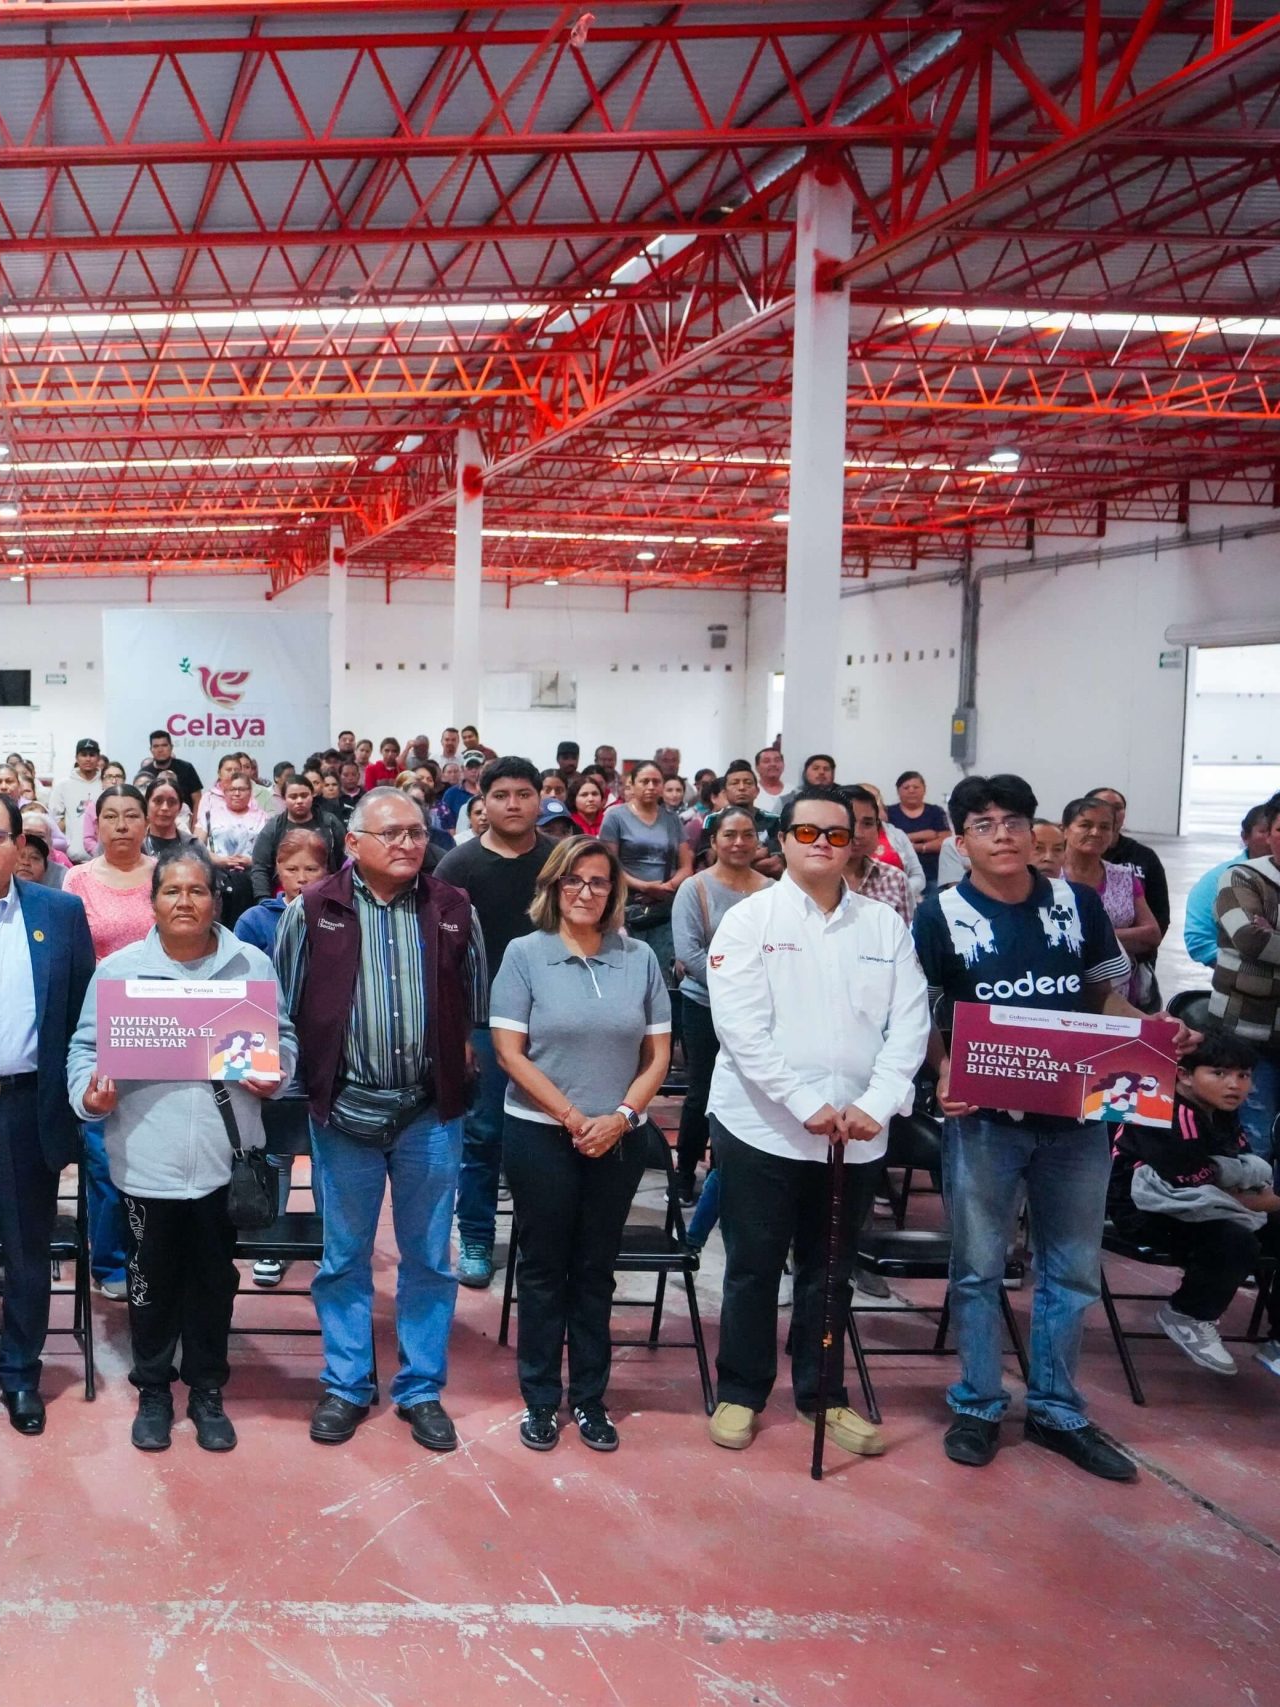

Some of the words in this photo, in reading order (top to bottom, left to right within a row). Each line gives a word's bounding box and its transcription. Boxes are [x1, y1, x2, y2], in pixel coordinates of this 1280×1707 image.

[166, 713, 266, 740] Celaya
[198, 740, 266, 750] esperanza
[975, 971, 1081, 1000] codere
[110, 1016, 179, 1026] VIVIENDA
[110, 1027, 155, 1037] DIGNA
[159, 1027, 196, 1037] PARA
[200, 1027, 216, 1037] EL
[110, 1038, 187, 1048] BIENESTAR
[968, 1042, 1051, 1058] VIVIENDA
[967, 1053, 1021, 1067] DIGNA
[1026, 1058, 1070, 1072] PARA
[1075, 1064, 1096, 1074] EL
[966, 1064, 1058, 1082] BIENESTAR
